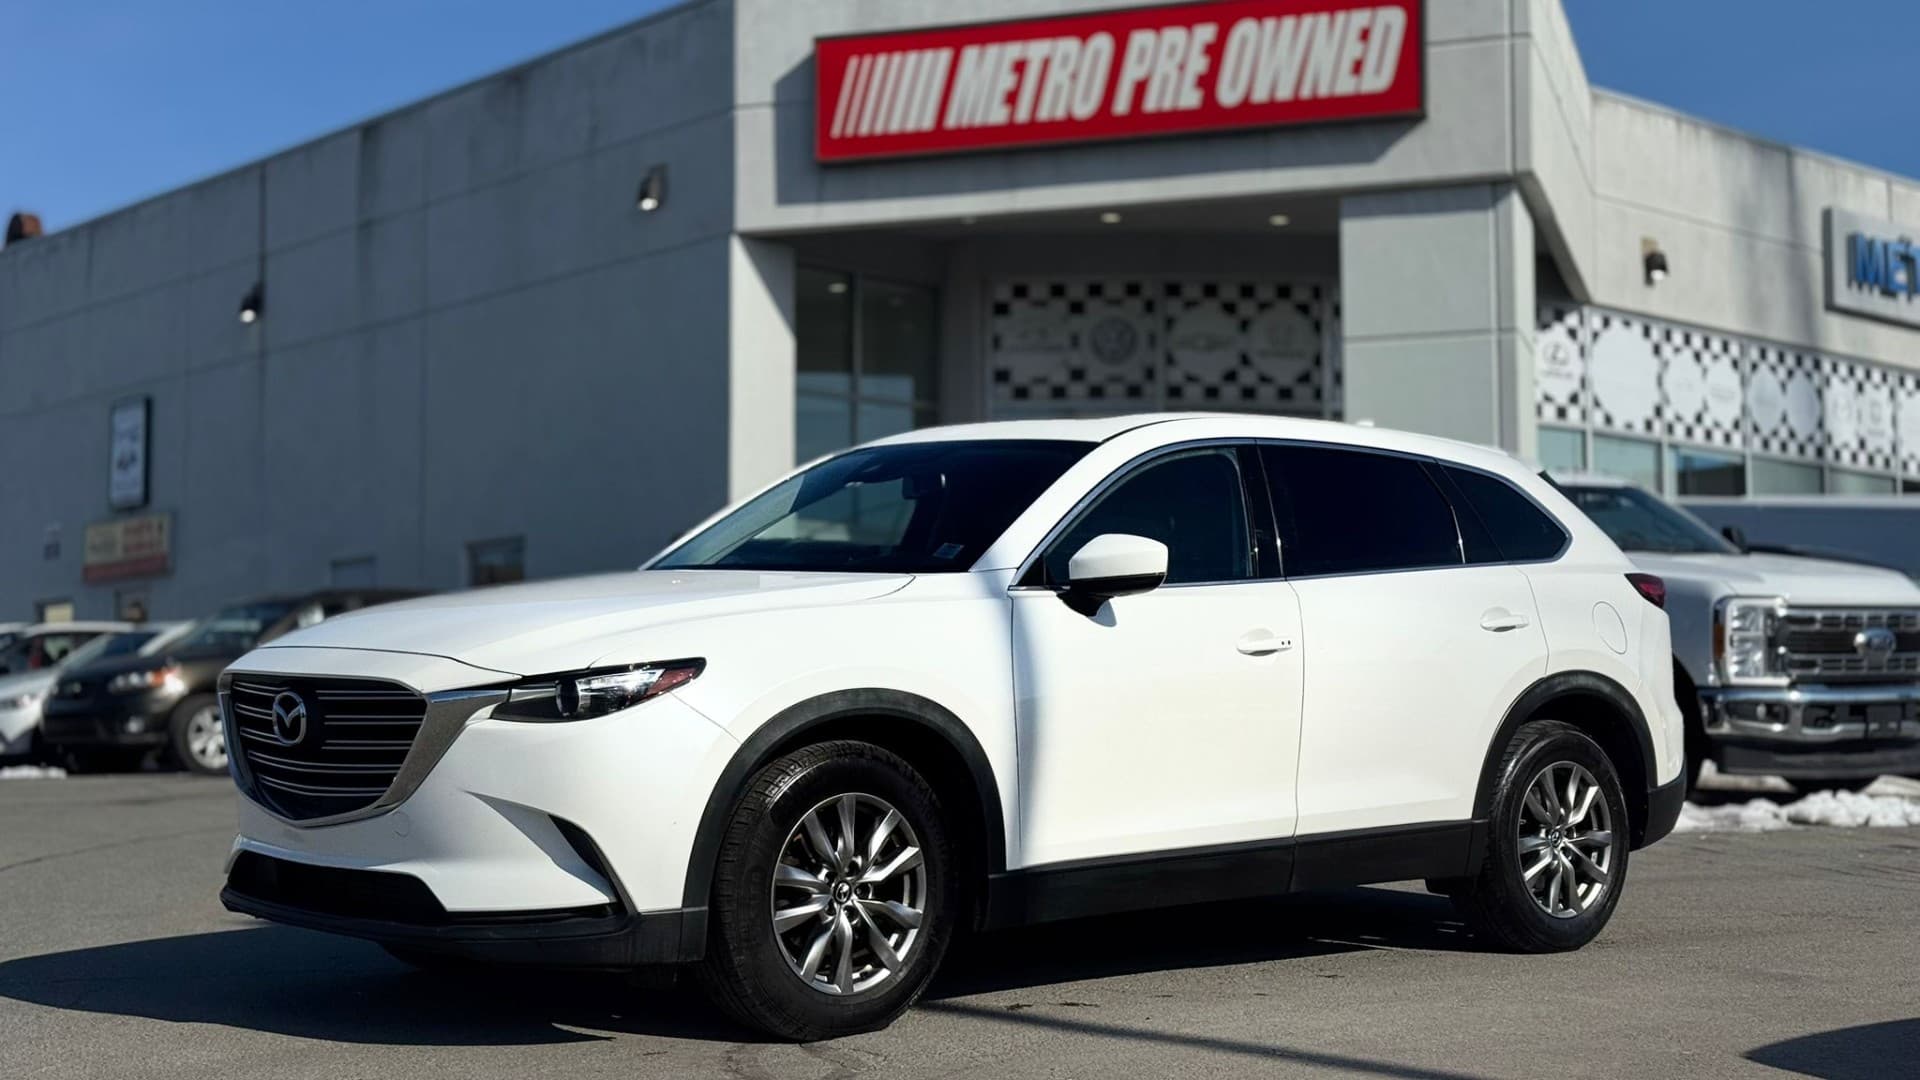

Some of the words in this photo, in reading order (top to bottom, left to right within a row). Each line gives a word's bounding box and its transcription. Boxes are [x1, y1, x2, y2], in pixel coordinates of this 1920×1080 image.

[943, 33, 1114, 129] METRO
[1112, 23, 1217, 115] PRE
[1216, 6, 1407, 108] OWNED
